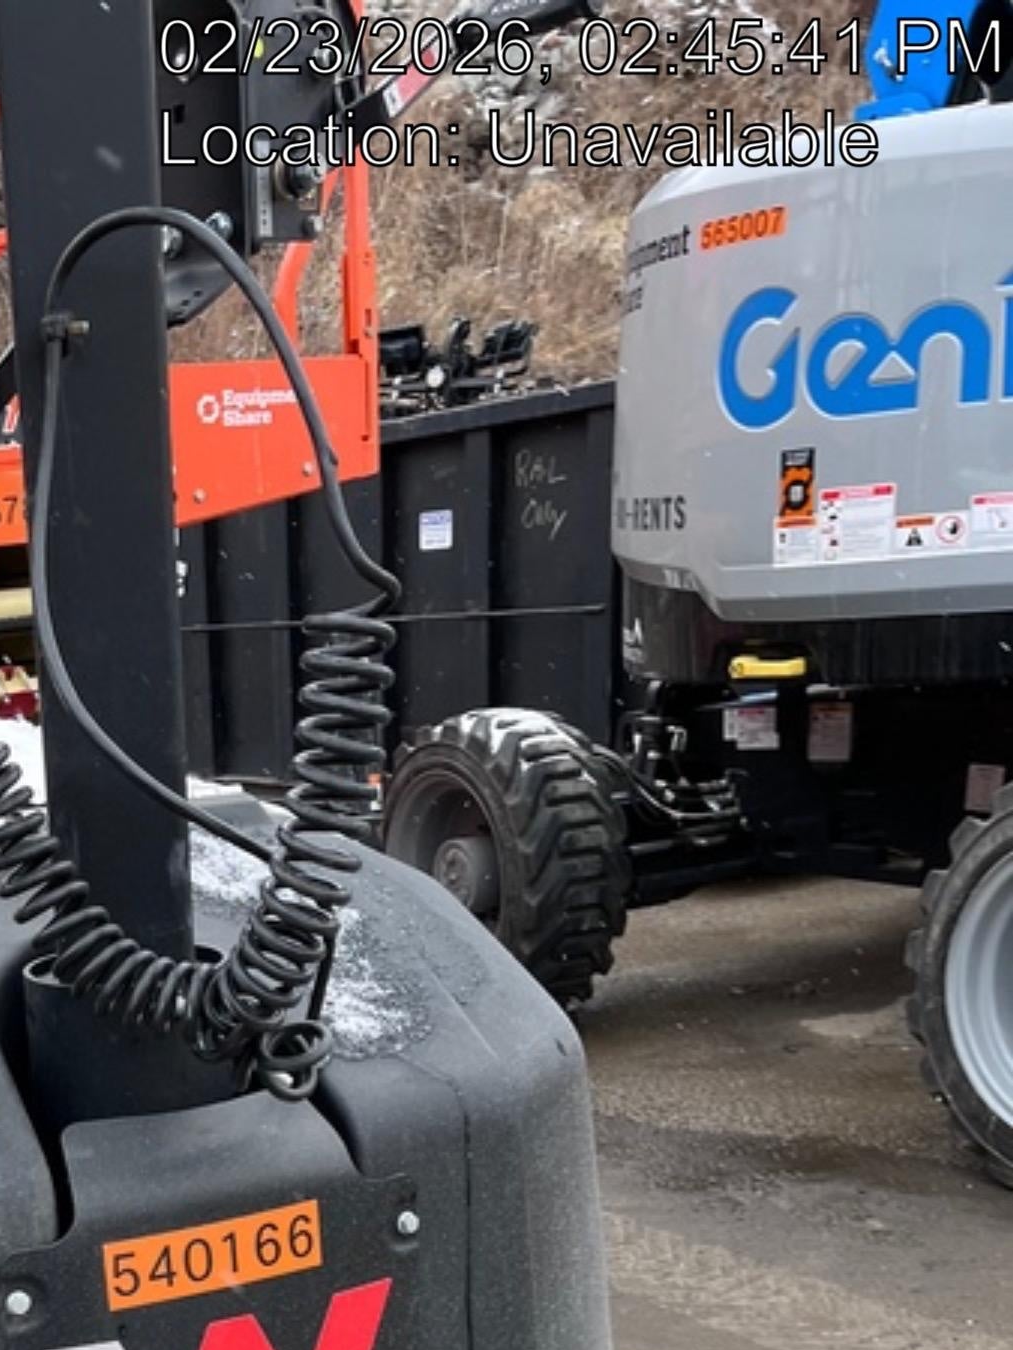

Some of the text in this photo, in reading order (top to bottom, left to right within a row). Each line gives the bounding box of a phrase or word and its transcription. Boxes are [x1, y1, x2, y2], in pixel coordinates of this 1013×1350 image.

[701, 206, 785, 250] 565007
[222, 387, 297, 409] Equipme
[223, 409, 273, 427] Share
[111, 1213, 315, 1298] 540166
